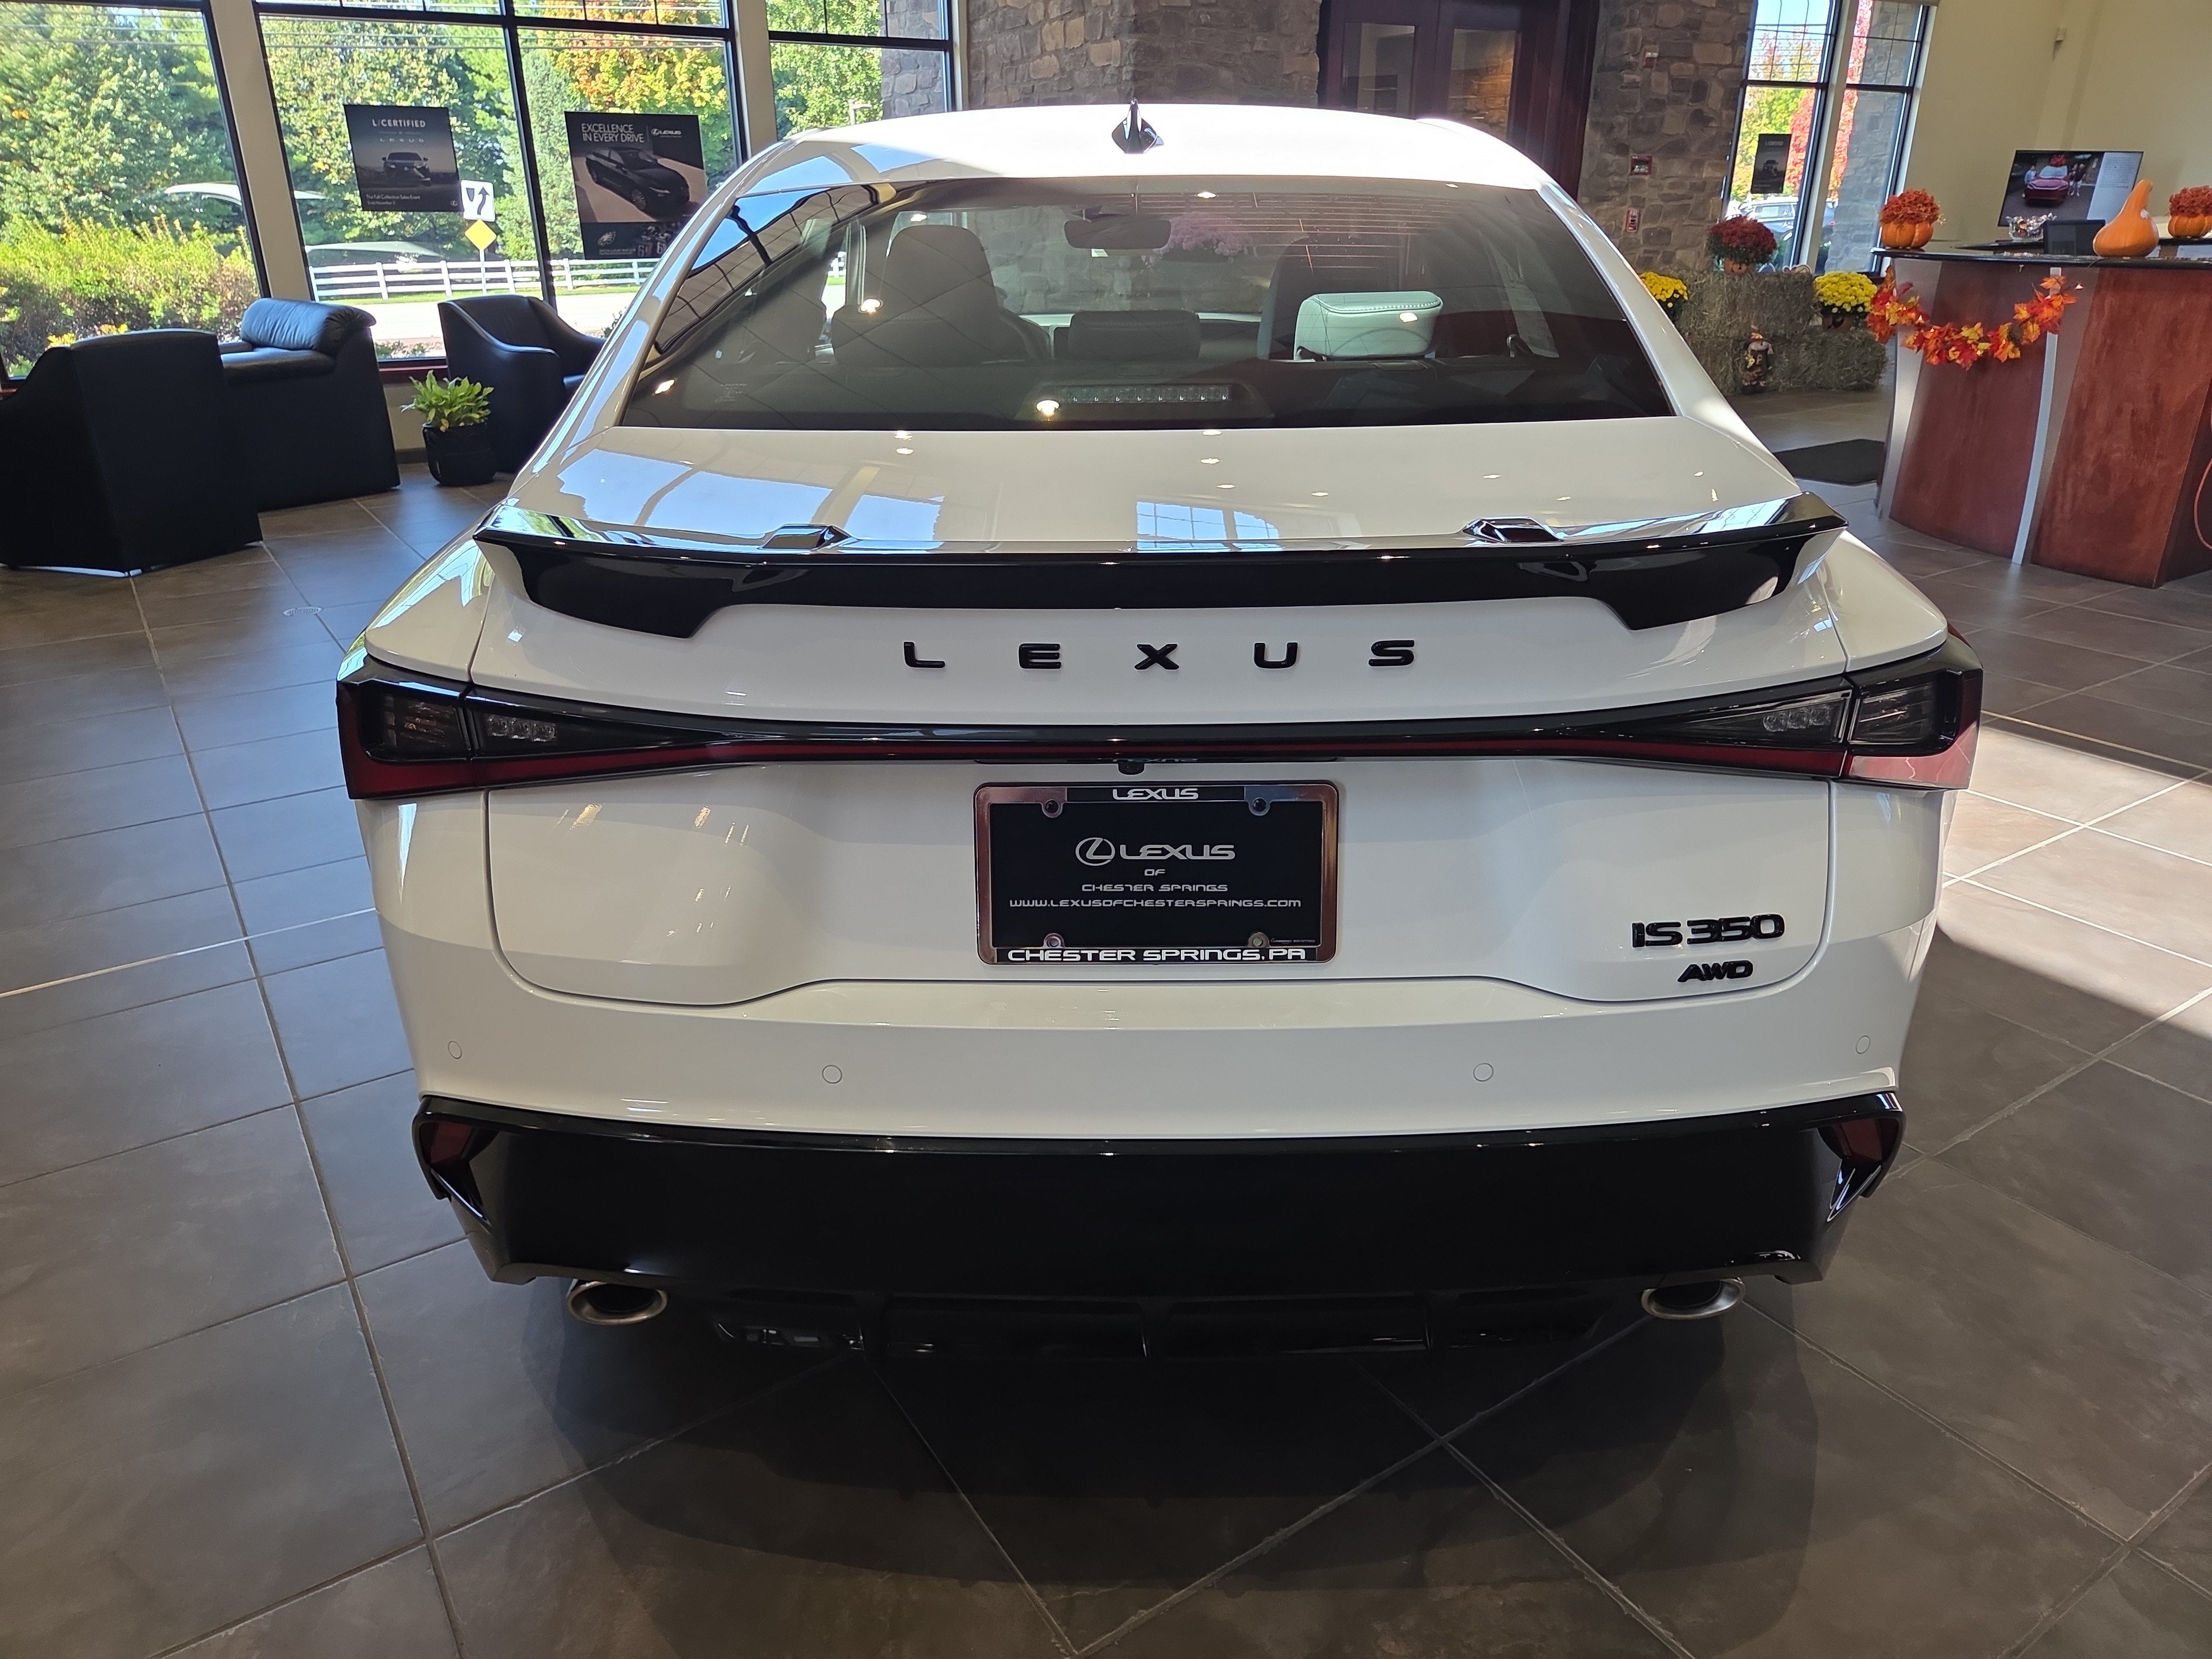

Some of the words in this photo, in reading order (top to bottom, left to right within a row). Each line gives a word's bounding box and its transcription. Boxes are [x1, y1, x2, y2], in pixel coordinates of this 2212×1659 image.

[581, 123, 634, 133] EXCELLENCE
[583, 133, 592, 142] IN
[594, 133, 619, 142] EVERY
[621, 133, 645, 143] DRIVE
[904, 641, 1414, 670] LEXUS
[1112, 788, 1199, 800] LEXUS
[1120, 845, 1236, 860] LEXUS
[1632, 922, 1683, 948] IS
[1687, 914, 1784, 944] 350
[1008, 949, 1136, 961] CHESTER
[1269, 949, 1306, 960] PA
[1677, 960, 1753, 982] AWD
